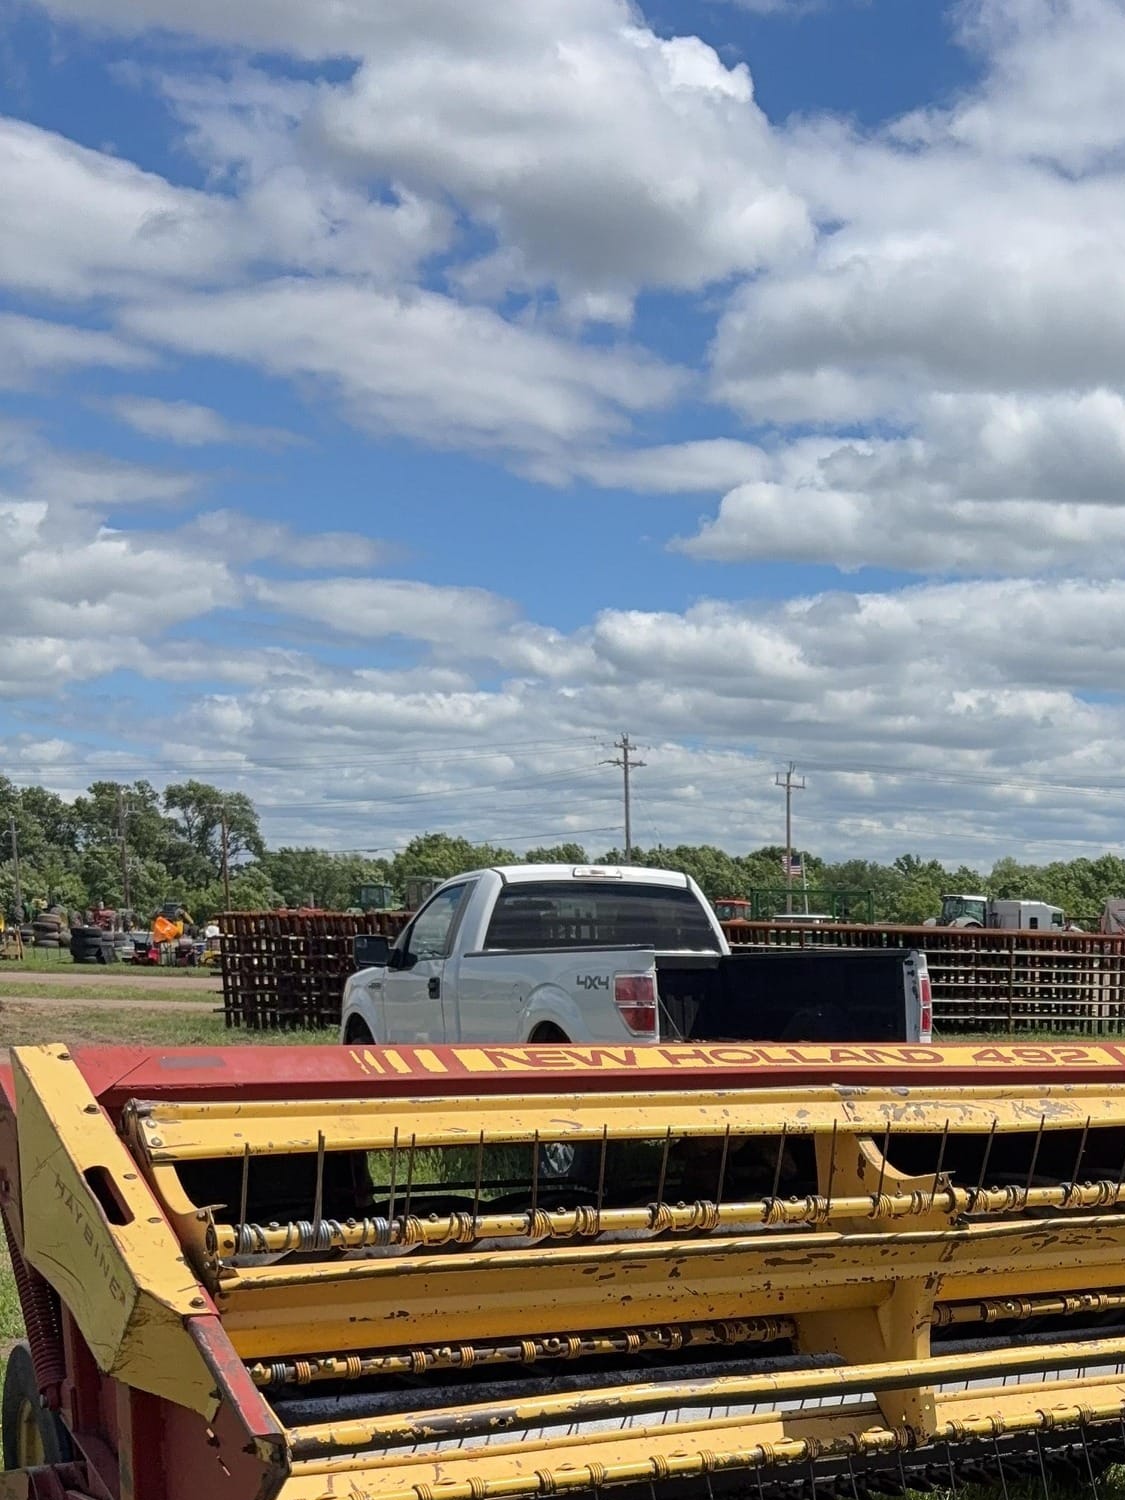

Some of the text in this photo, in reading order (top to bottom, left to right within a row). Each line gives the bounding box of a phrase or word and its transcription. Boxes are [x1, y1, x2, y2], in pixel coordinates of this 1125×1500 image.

[481, 1049, 1098, 1068] NEW HOLLAND 492
[55, 1173, 120, 1300] HAYBINE
